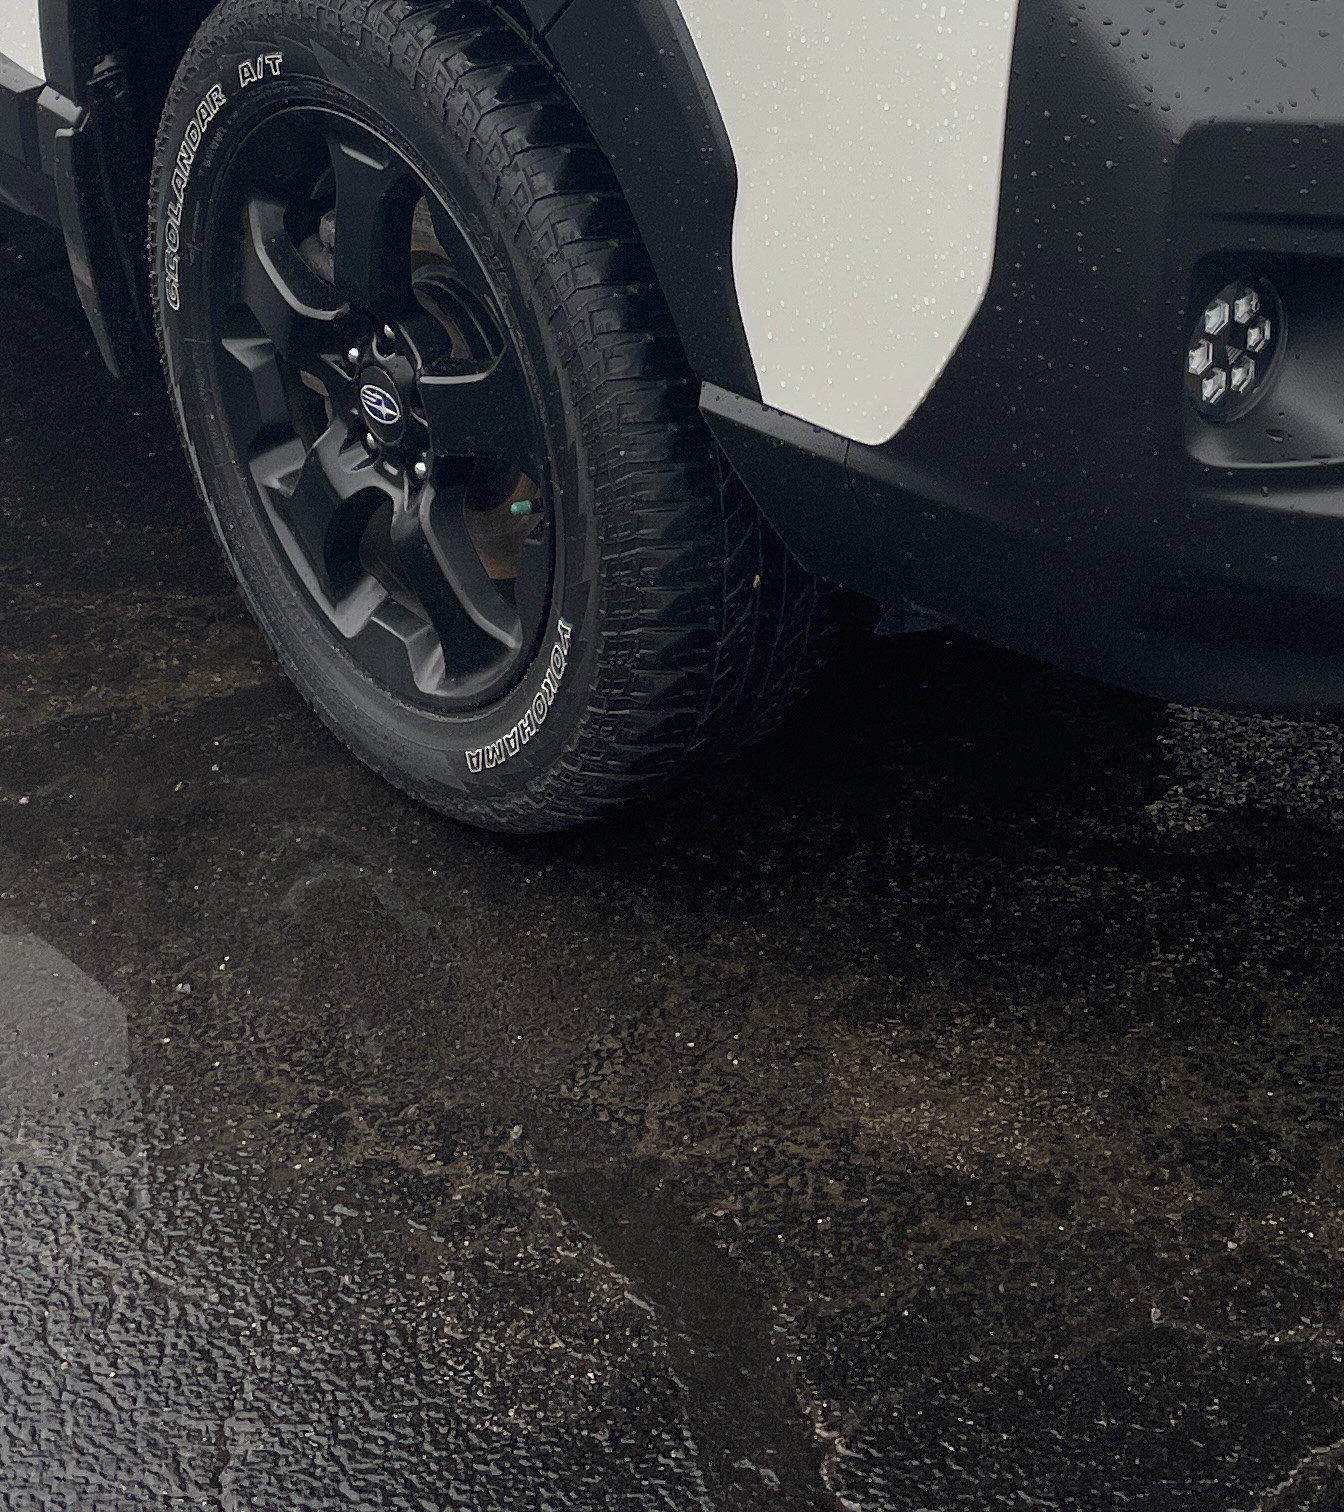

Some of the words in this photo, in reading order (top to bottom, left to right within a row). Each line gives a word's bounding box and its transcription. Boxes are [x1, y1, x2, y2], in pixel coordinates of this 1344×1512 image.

[165, 84, 226, 310] GEOLANDAR
[237, 52, 283, 88] A/T
[465, 617, 573, 774] YOKOHAMA
